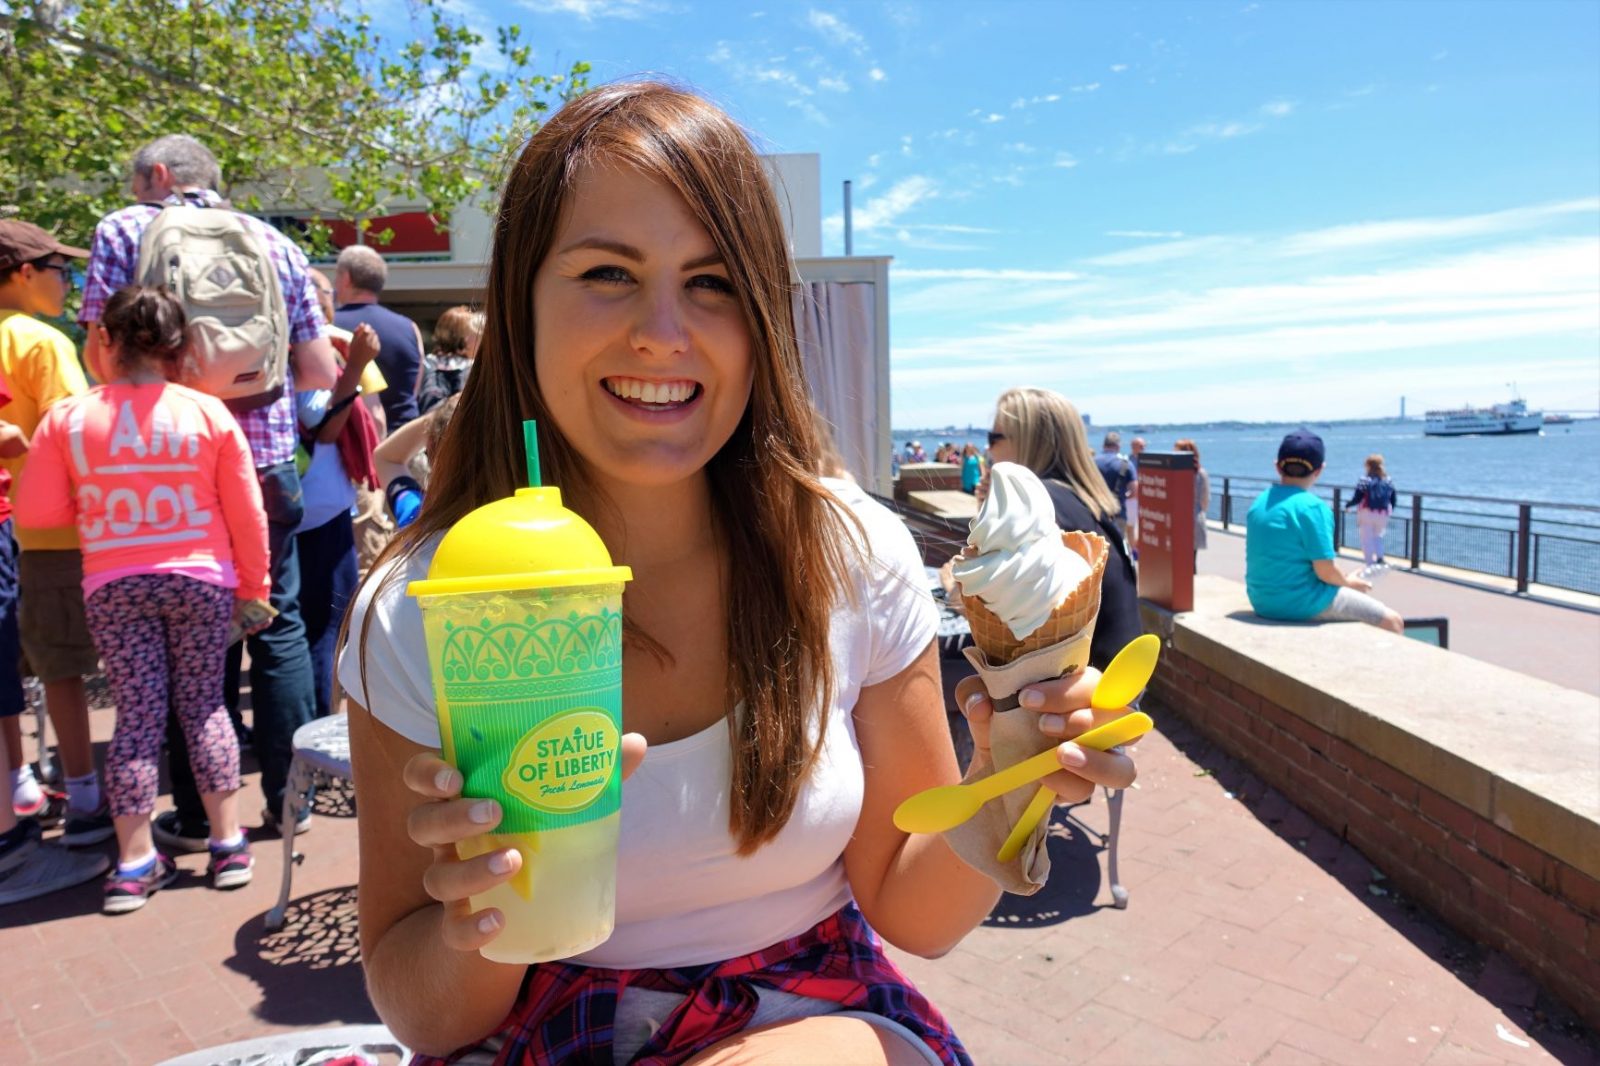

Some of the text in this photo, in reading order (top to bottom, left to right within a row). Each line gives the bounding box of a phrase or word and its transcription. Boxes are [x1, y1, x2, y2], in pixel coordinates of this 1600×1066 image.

[69, 400, 200, 477] I AM
[79, 484, 212, 539] COOL
[537, 730, 604, 758] STATUE
[518, 749, 614, 782] OF LIBERTY
[540, 776, 605, 797] Fresh Lemonade
